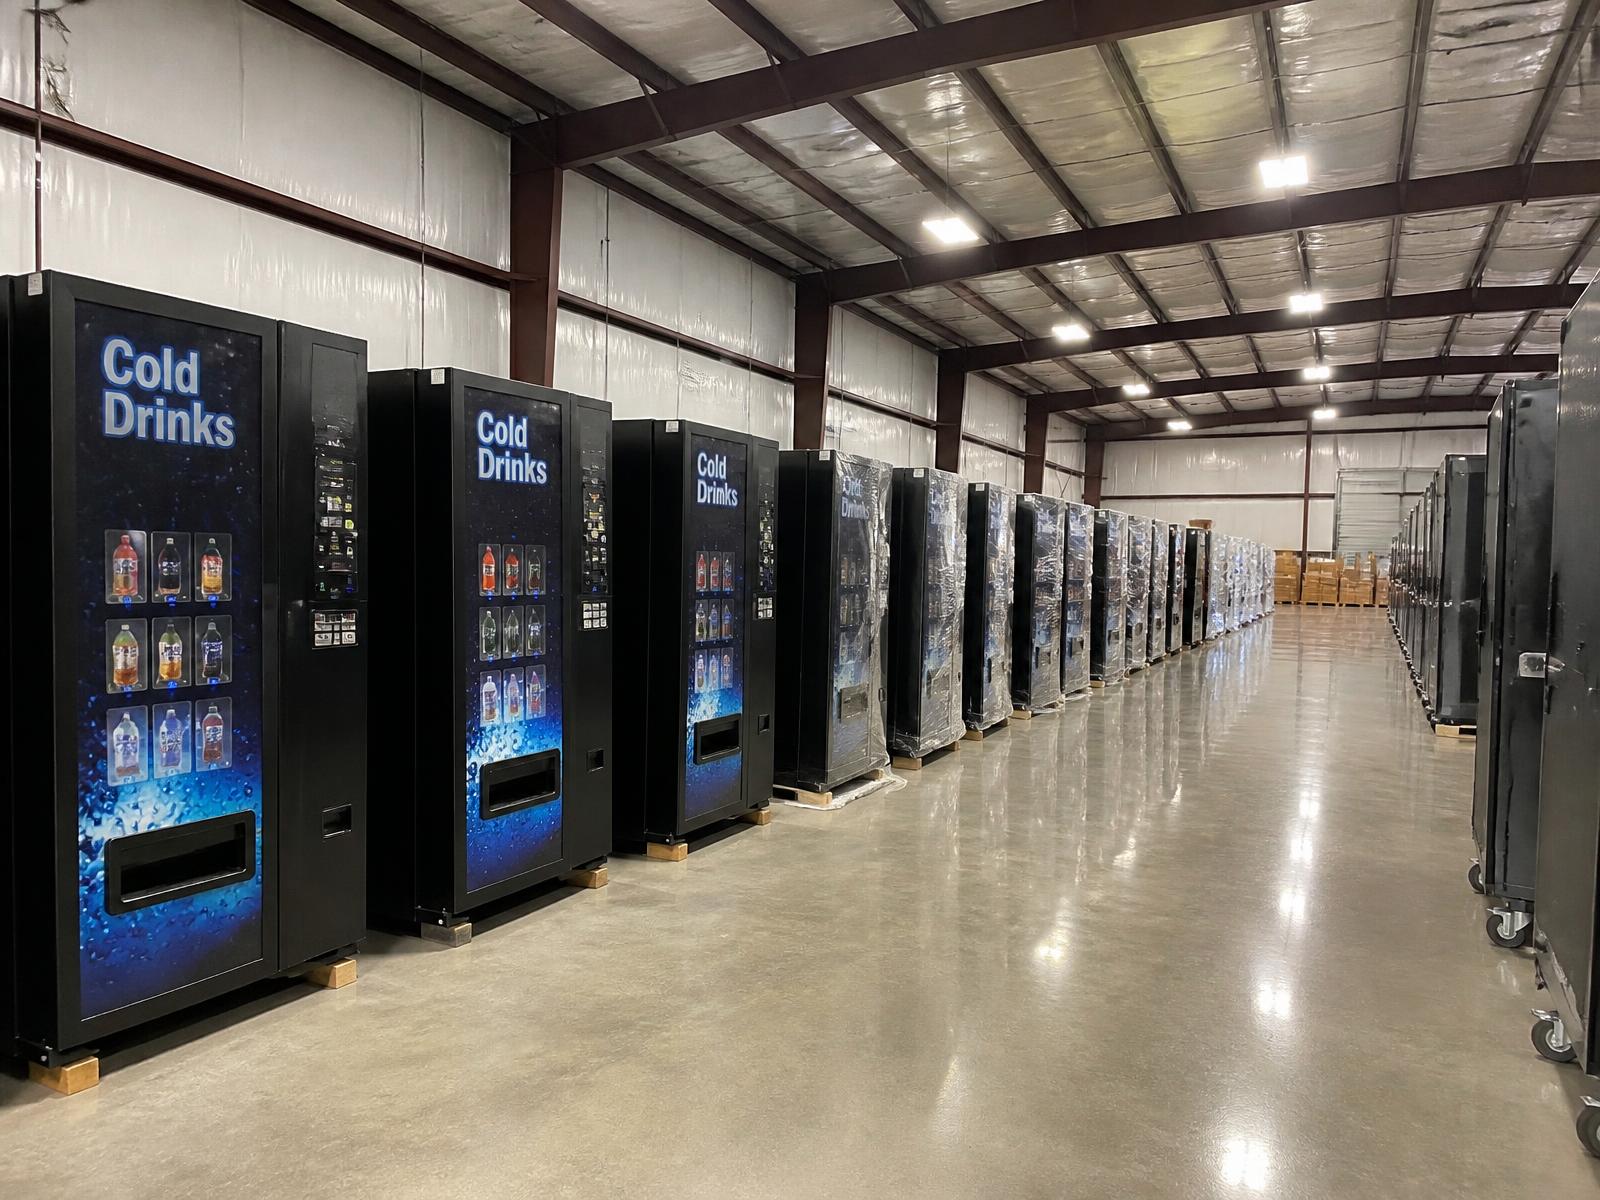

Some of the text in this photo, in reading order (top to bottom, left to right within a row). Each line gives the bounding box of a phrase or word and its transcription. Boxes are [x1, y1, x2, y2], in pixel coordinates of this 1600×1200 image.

[103, 337, 199, 395] Cold
[104, 390, 235, 447] Drinks
[478, 411, 528, 448] Cold
[478, 447, 547, 485] Drinks
[697, 452, 727, 480] Cold
